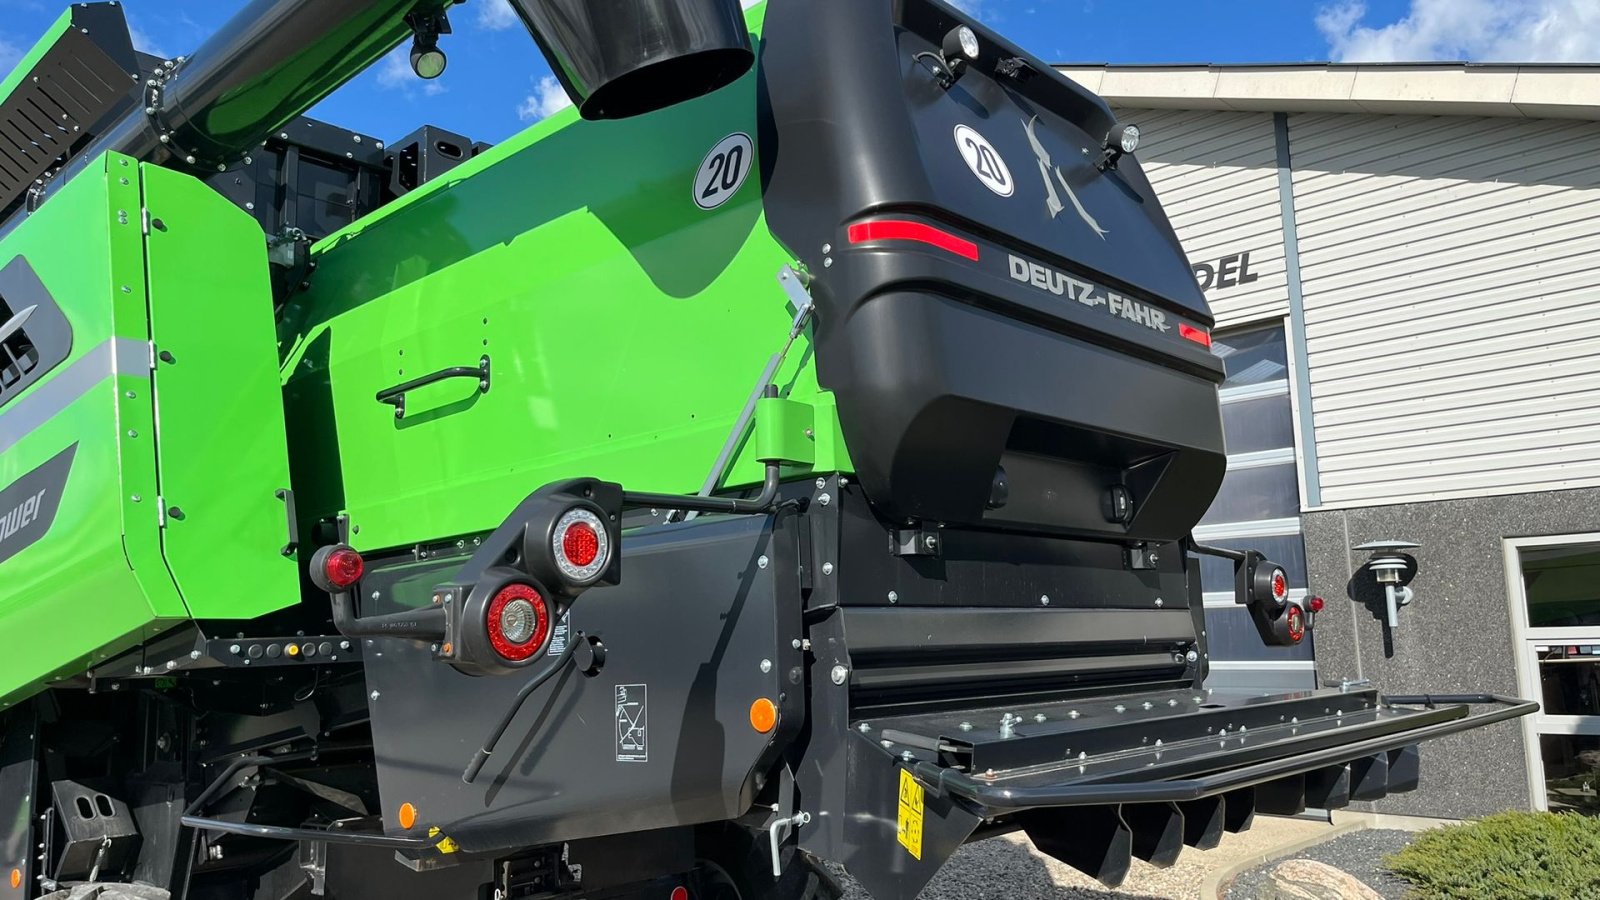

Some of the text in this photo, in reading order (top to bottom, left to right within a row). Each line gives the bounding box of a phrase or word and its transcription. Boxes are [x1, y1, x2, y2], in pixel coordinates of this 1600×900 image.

[702, 145, 743, 199] 20
[965, 137, 1006, 186] 20
[1008, 253, 1171, 333] DEUTZ-FAHR
